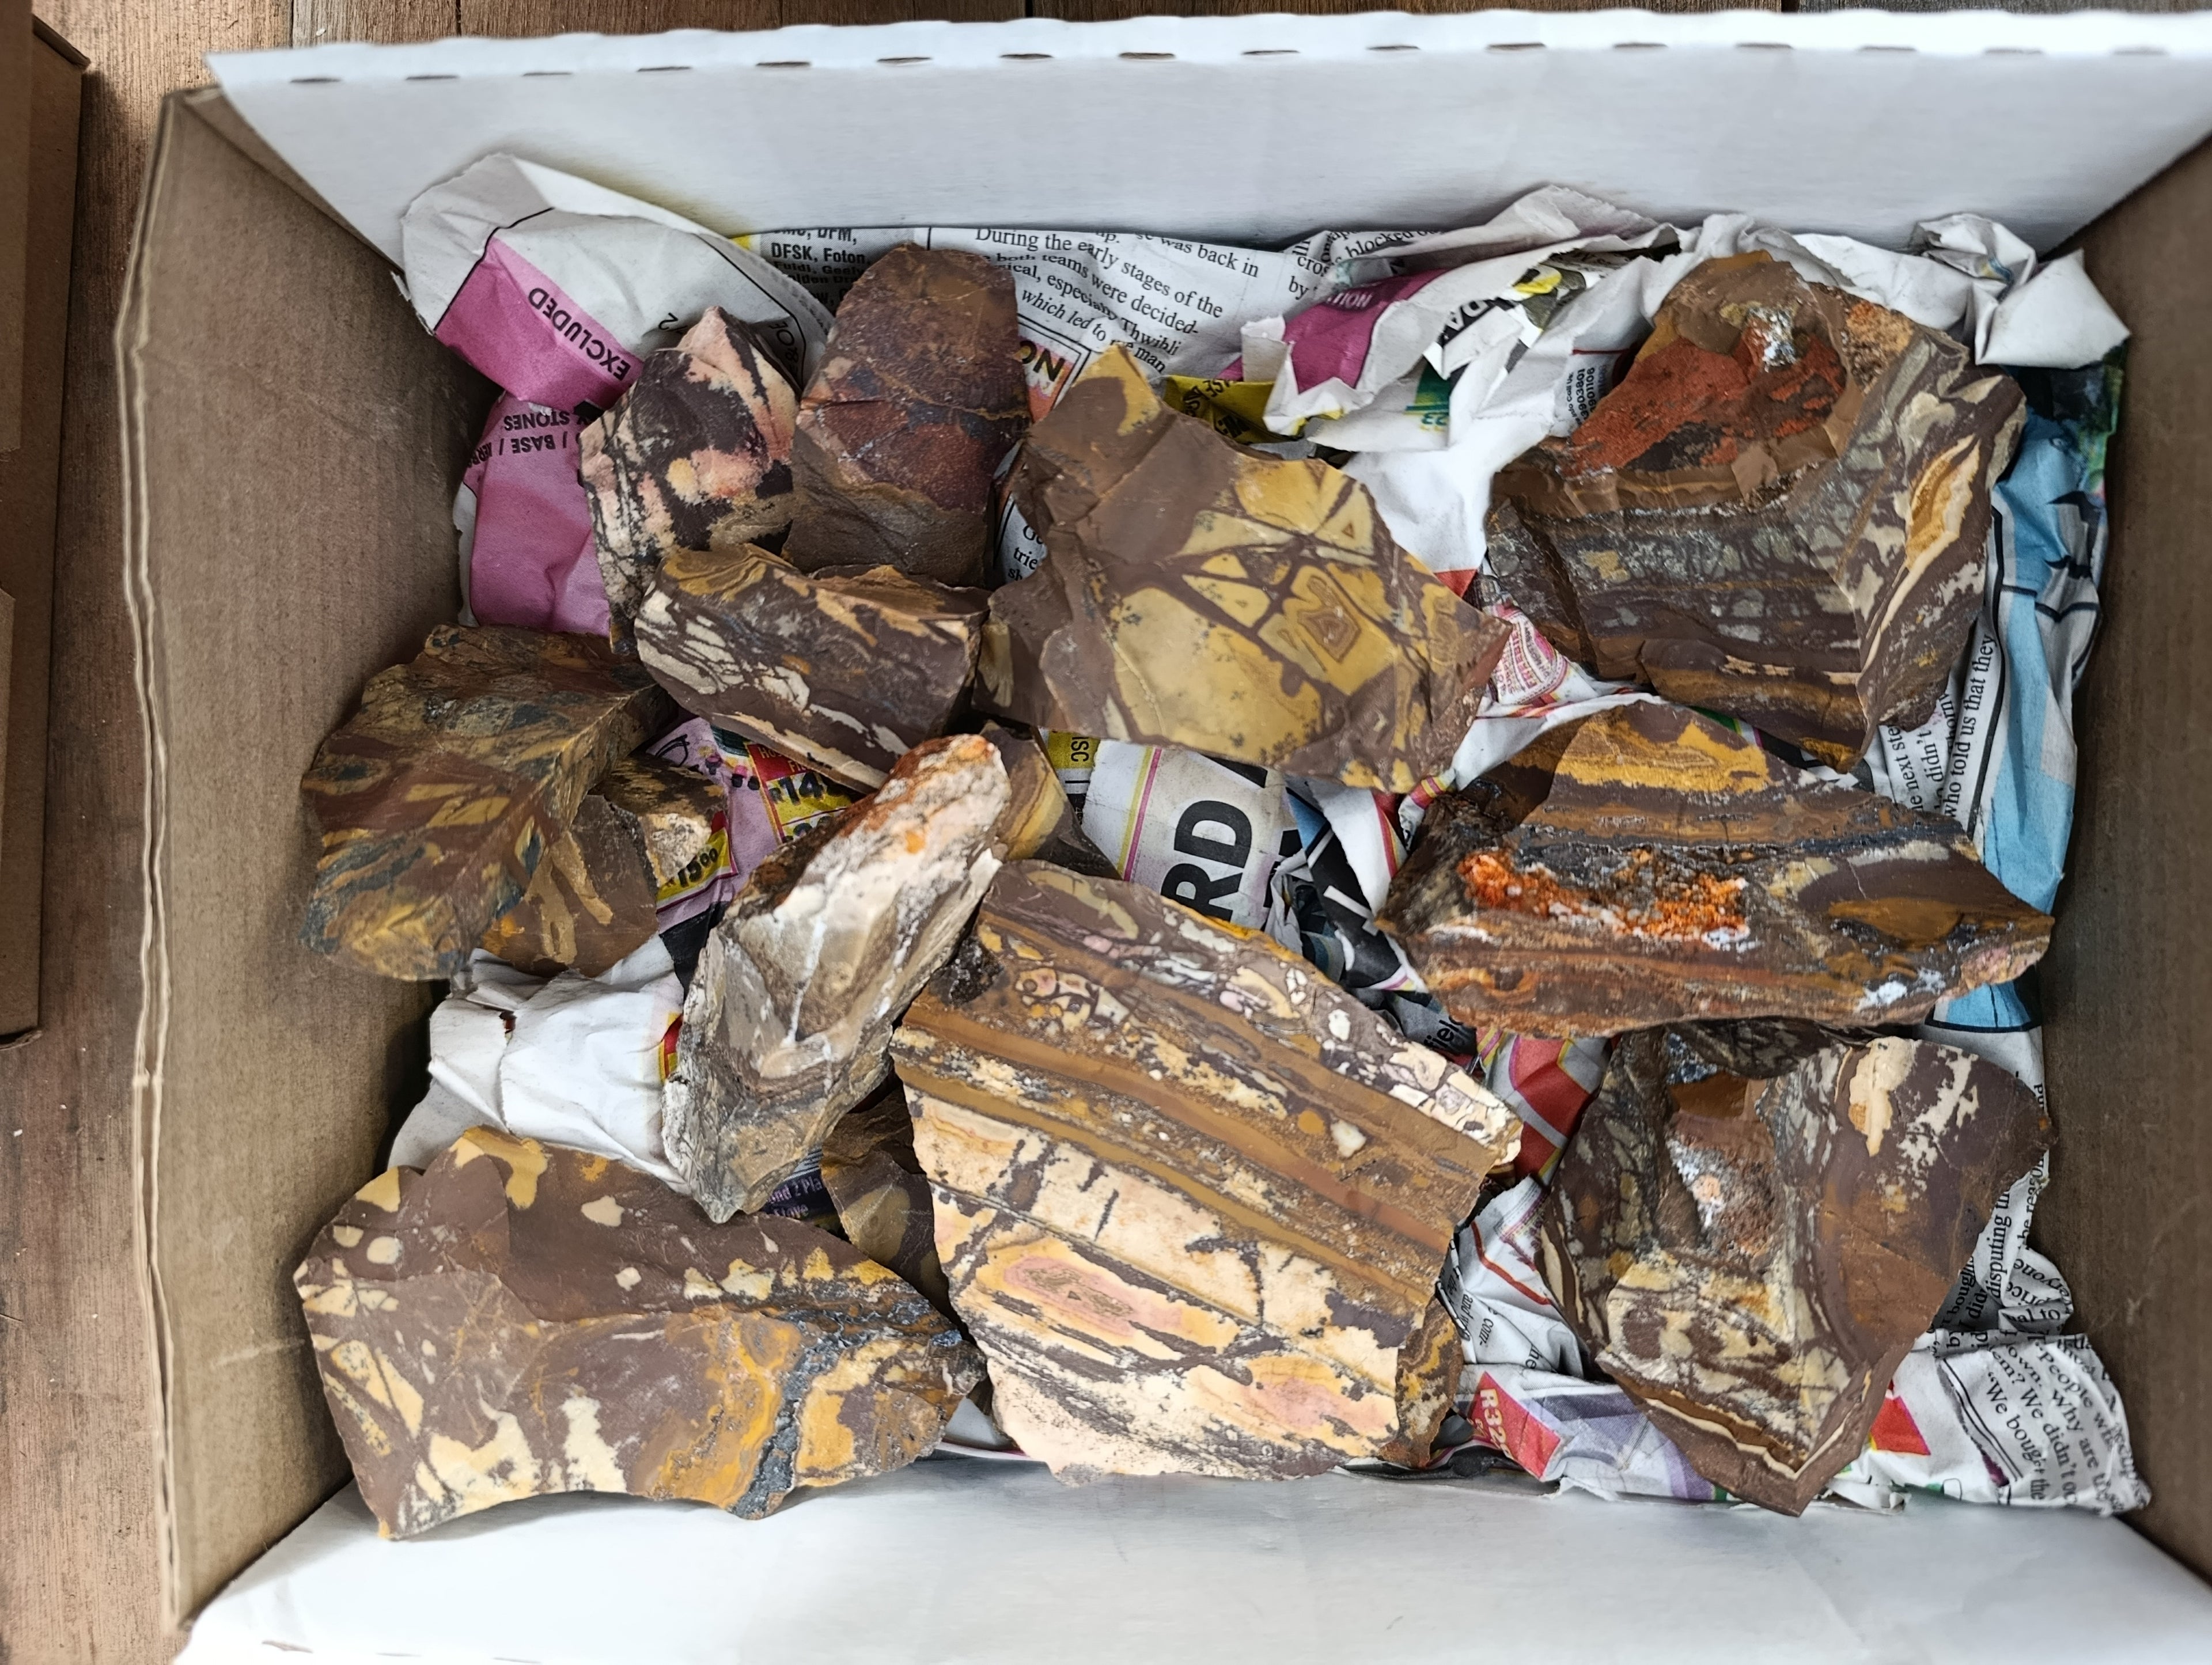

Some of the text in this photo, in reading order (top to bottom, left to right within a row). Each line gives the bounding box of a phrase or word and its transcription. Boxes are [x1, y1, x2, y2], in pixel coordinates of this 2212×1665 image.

[771, 242, 818, 262] DFSK,
[975, 227, 1223, 318] During the early stages of the
[1197, 244, 1239, 270] back
[1241, 257, 1259, 278] in
[997, 253, 1199, 334] both teams were decided-
[1288, 275, 1309, 300] by
[528, 287, 631, 381] EXCLUDED
[1022, 290, 1166, 374] which led to man
[503, 410, 570, 431] STONES
[510, 434, 556, 454] BASE
[1943, 634, 1997, 818] who told us that they
[1894, 754, 1920, 791] next
[1915, 729, 1944, 782] didn't
[1985, 1213, 2012, 1299] disputing
[1460, 1294, 1475, 1321] and
[2020, 1387, 2044, 1419] We
[2042, 1422, 2077, 1478] didn't
[2052, 1389, 2084, 1432] Why
[2078, 1438, 2099, 1469] are
[2030, 1478, 2050, 1501] the
